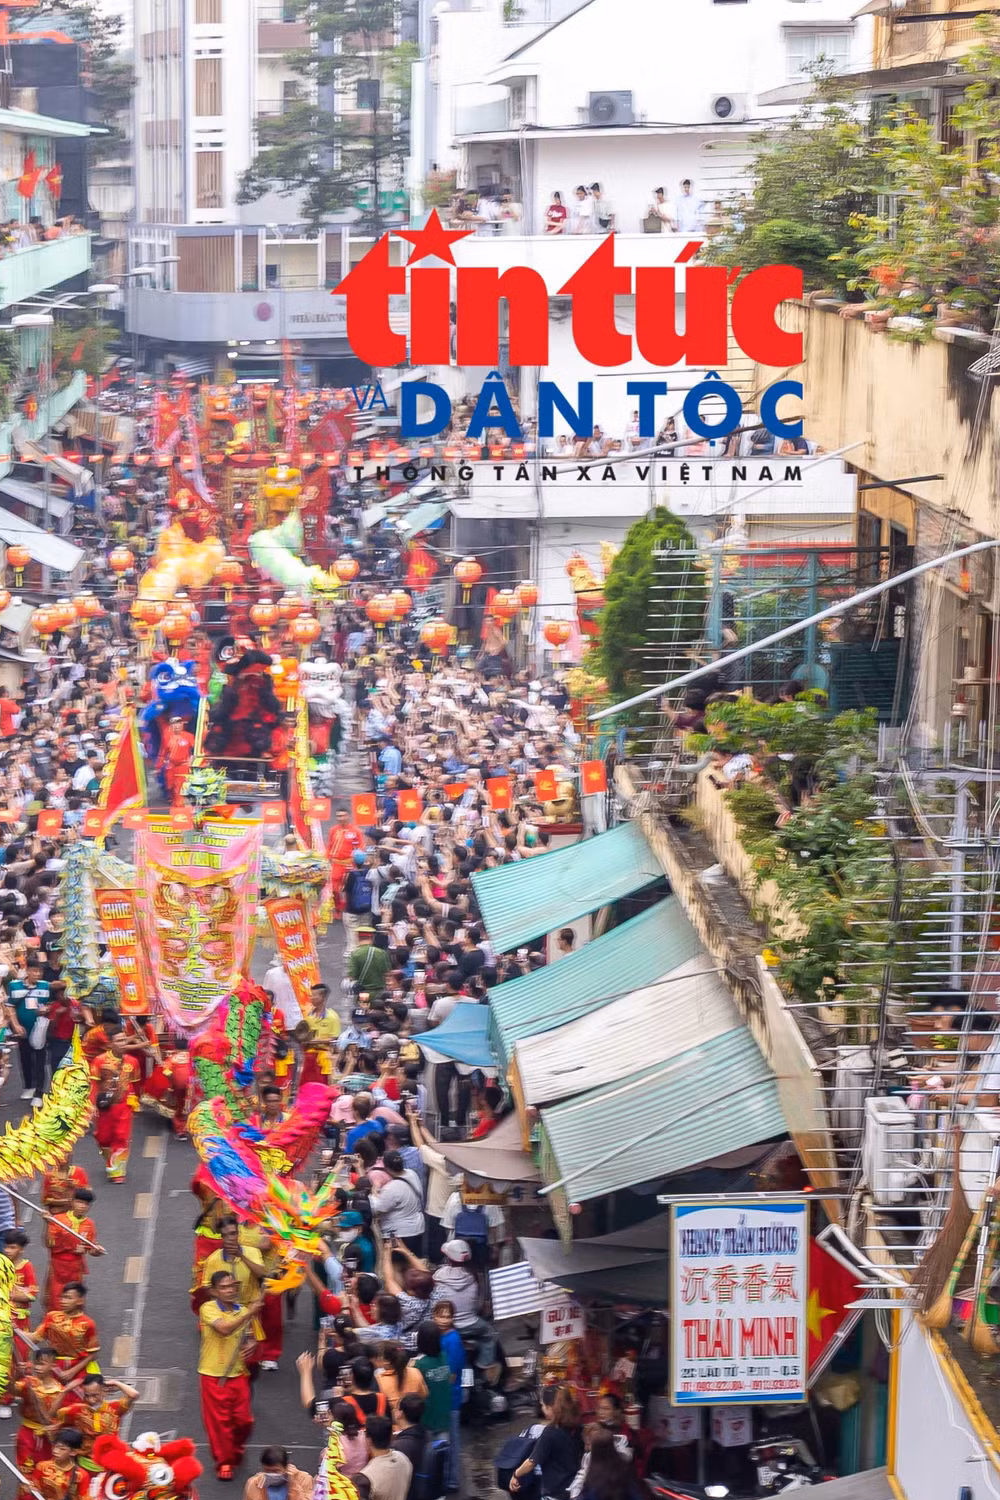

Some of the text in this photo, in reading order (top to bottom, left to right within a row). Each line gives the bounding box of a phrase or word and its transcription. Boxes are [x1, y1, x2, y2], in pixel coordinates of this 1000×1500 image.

[681, 1263, 799, 1306] 沉香香氣
[682, 1309, 799, 1359] THÁI MINH
